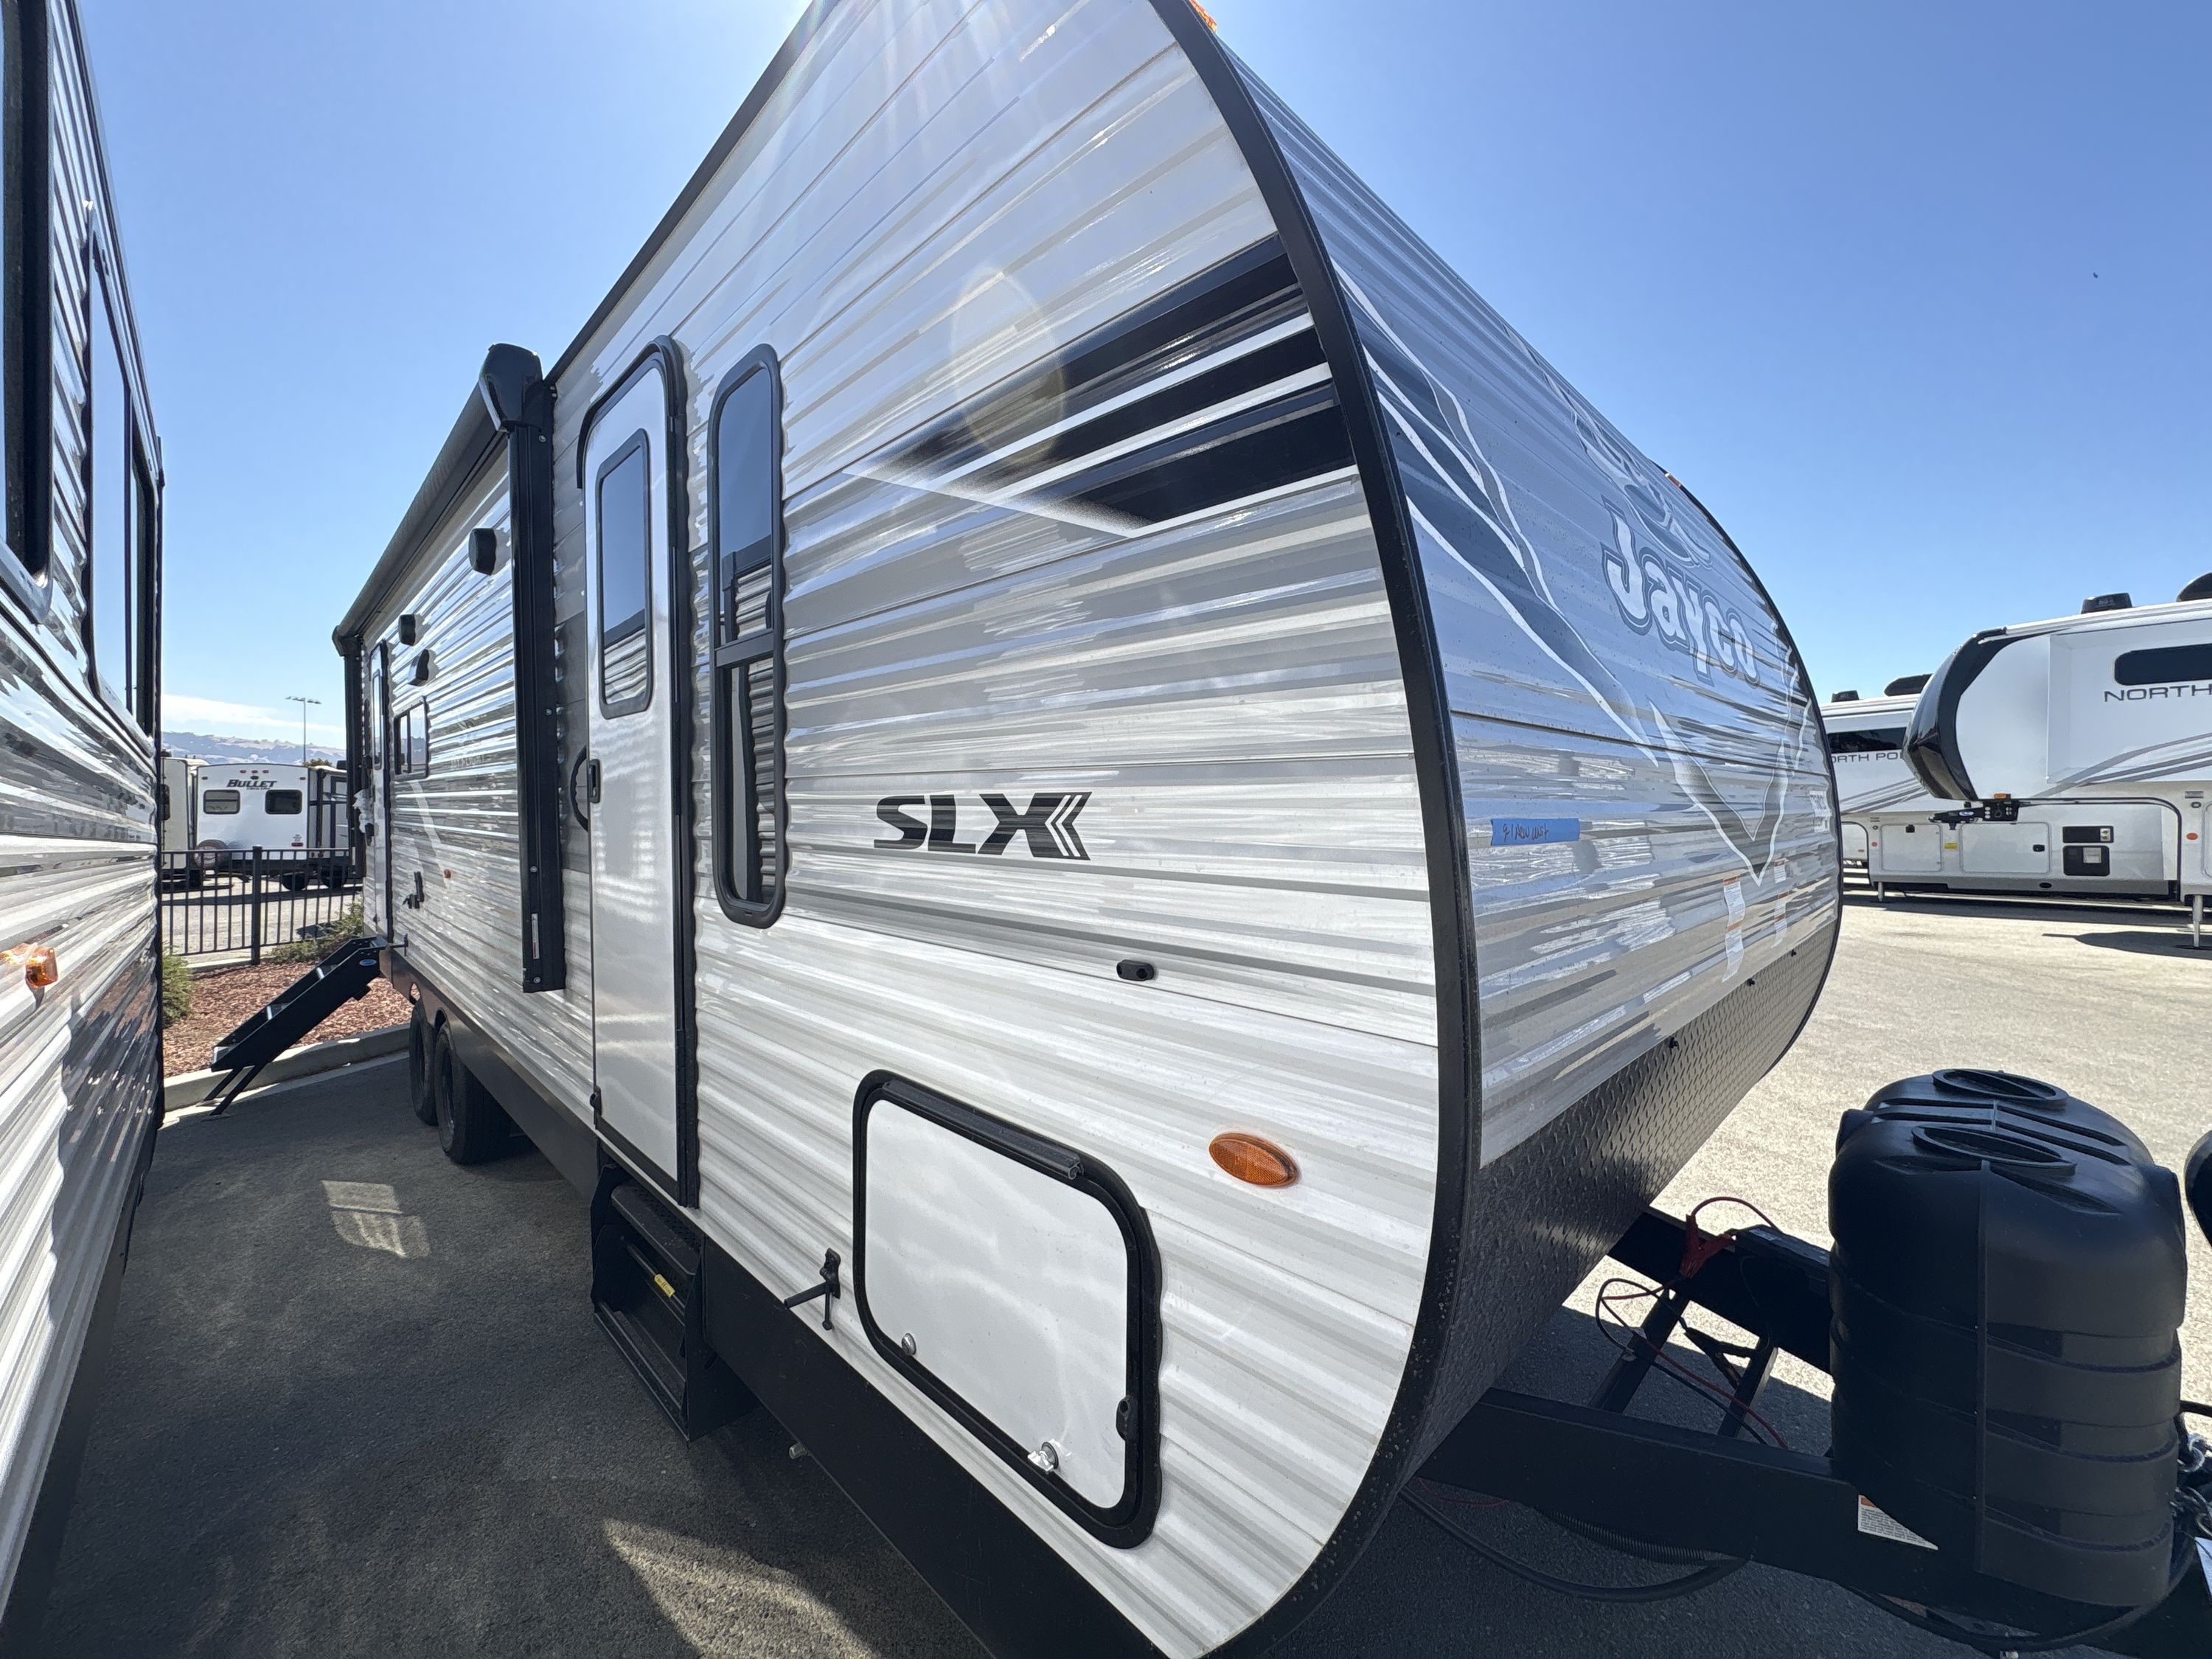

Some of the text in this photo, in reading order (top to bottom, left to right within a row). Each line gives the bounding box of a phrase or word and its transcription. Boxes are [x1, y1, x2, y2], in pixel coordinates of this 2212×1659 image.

[1600, 495, 1760, 689] Jayco
[2104, 684, 2212, 702] NORTH
[226, 779, 277, 787] BULLET
[874, 791, 1092, 860] SLX
